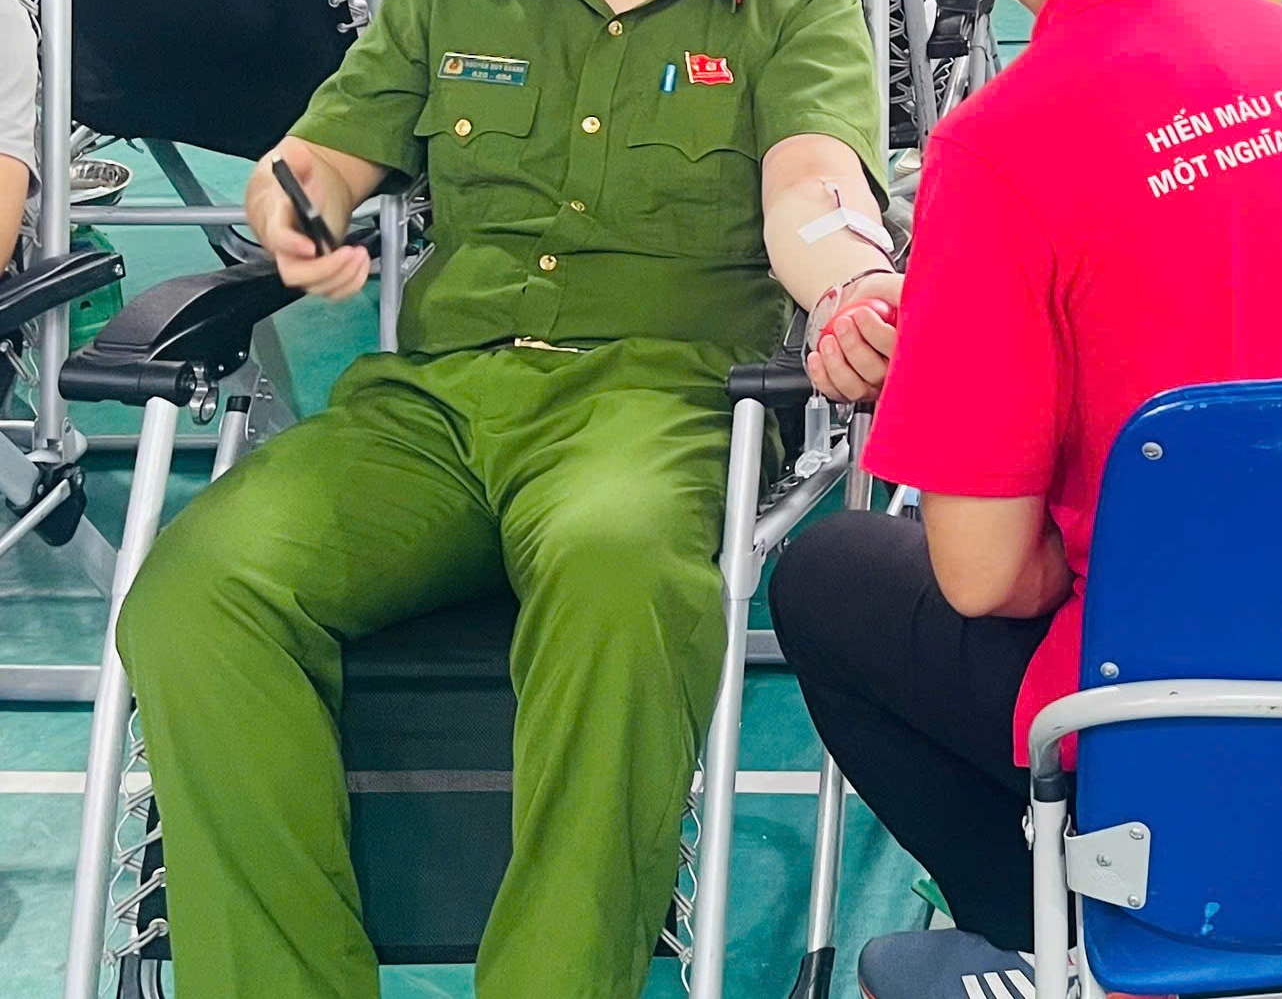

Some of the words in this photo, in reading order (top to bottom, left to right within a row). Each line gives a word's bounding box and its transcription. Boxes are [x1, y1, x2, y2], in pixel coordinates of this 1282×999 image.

[1145, 107, 1214, 153] HIẾN
[1212, 94, 1272, 129] MÁU
[1146, 155, 1210, 199] MỘT
